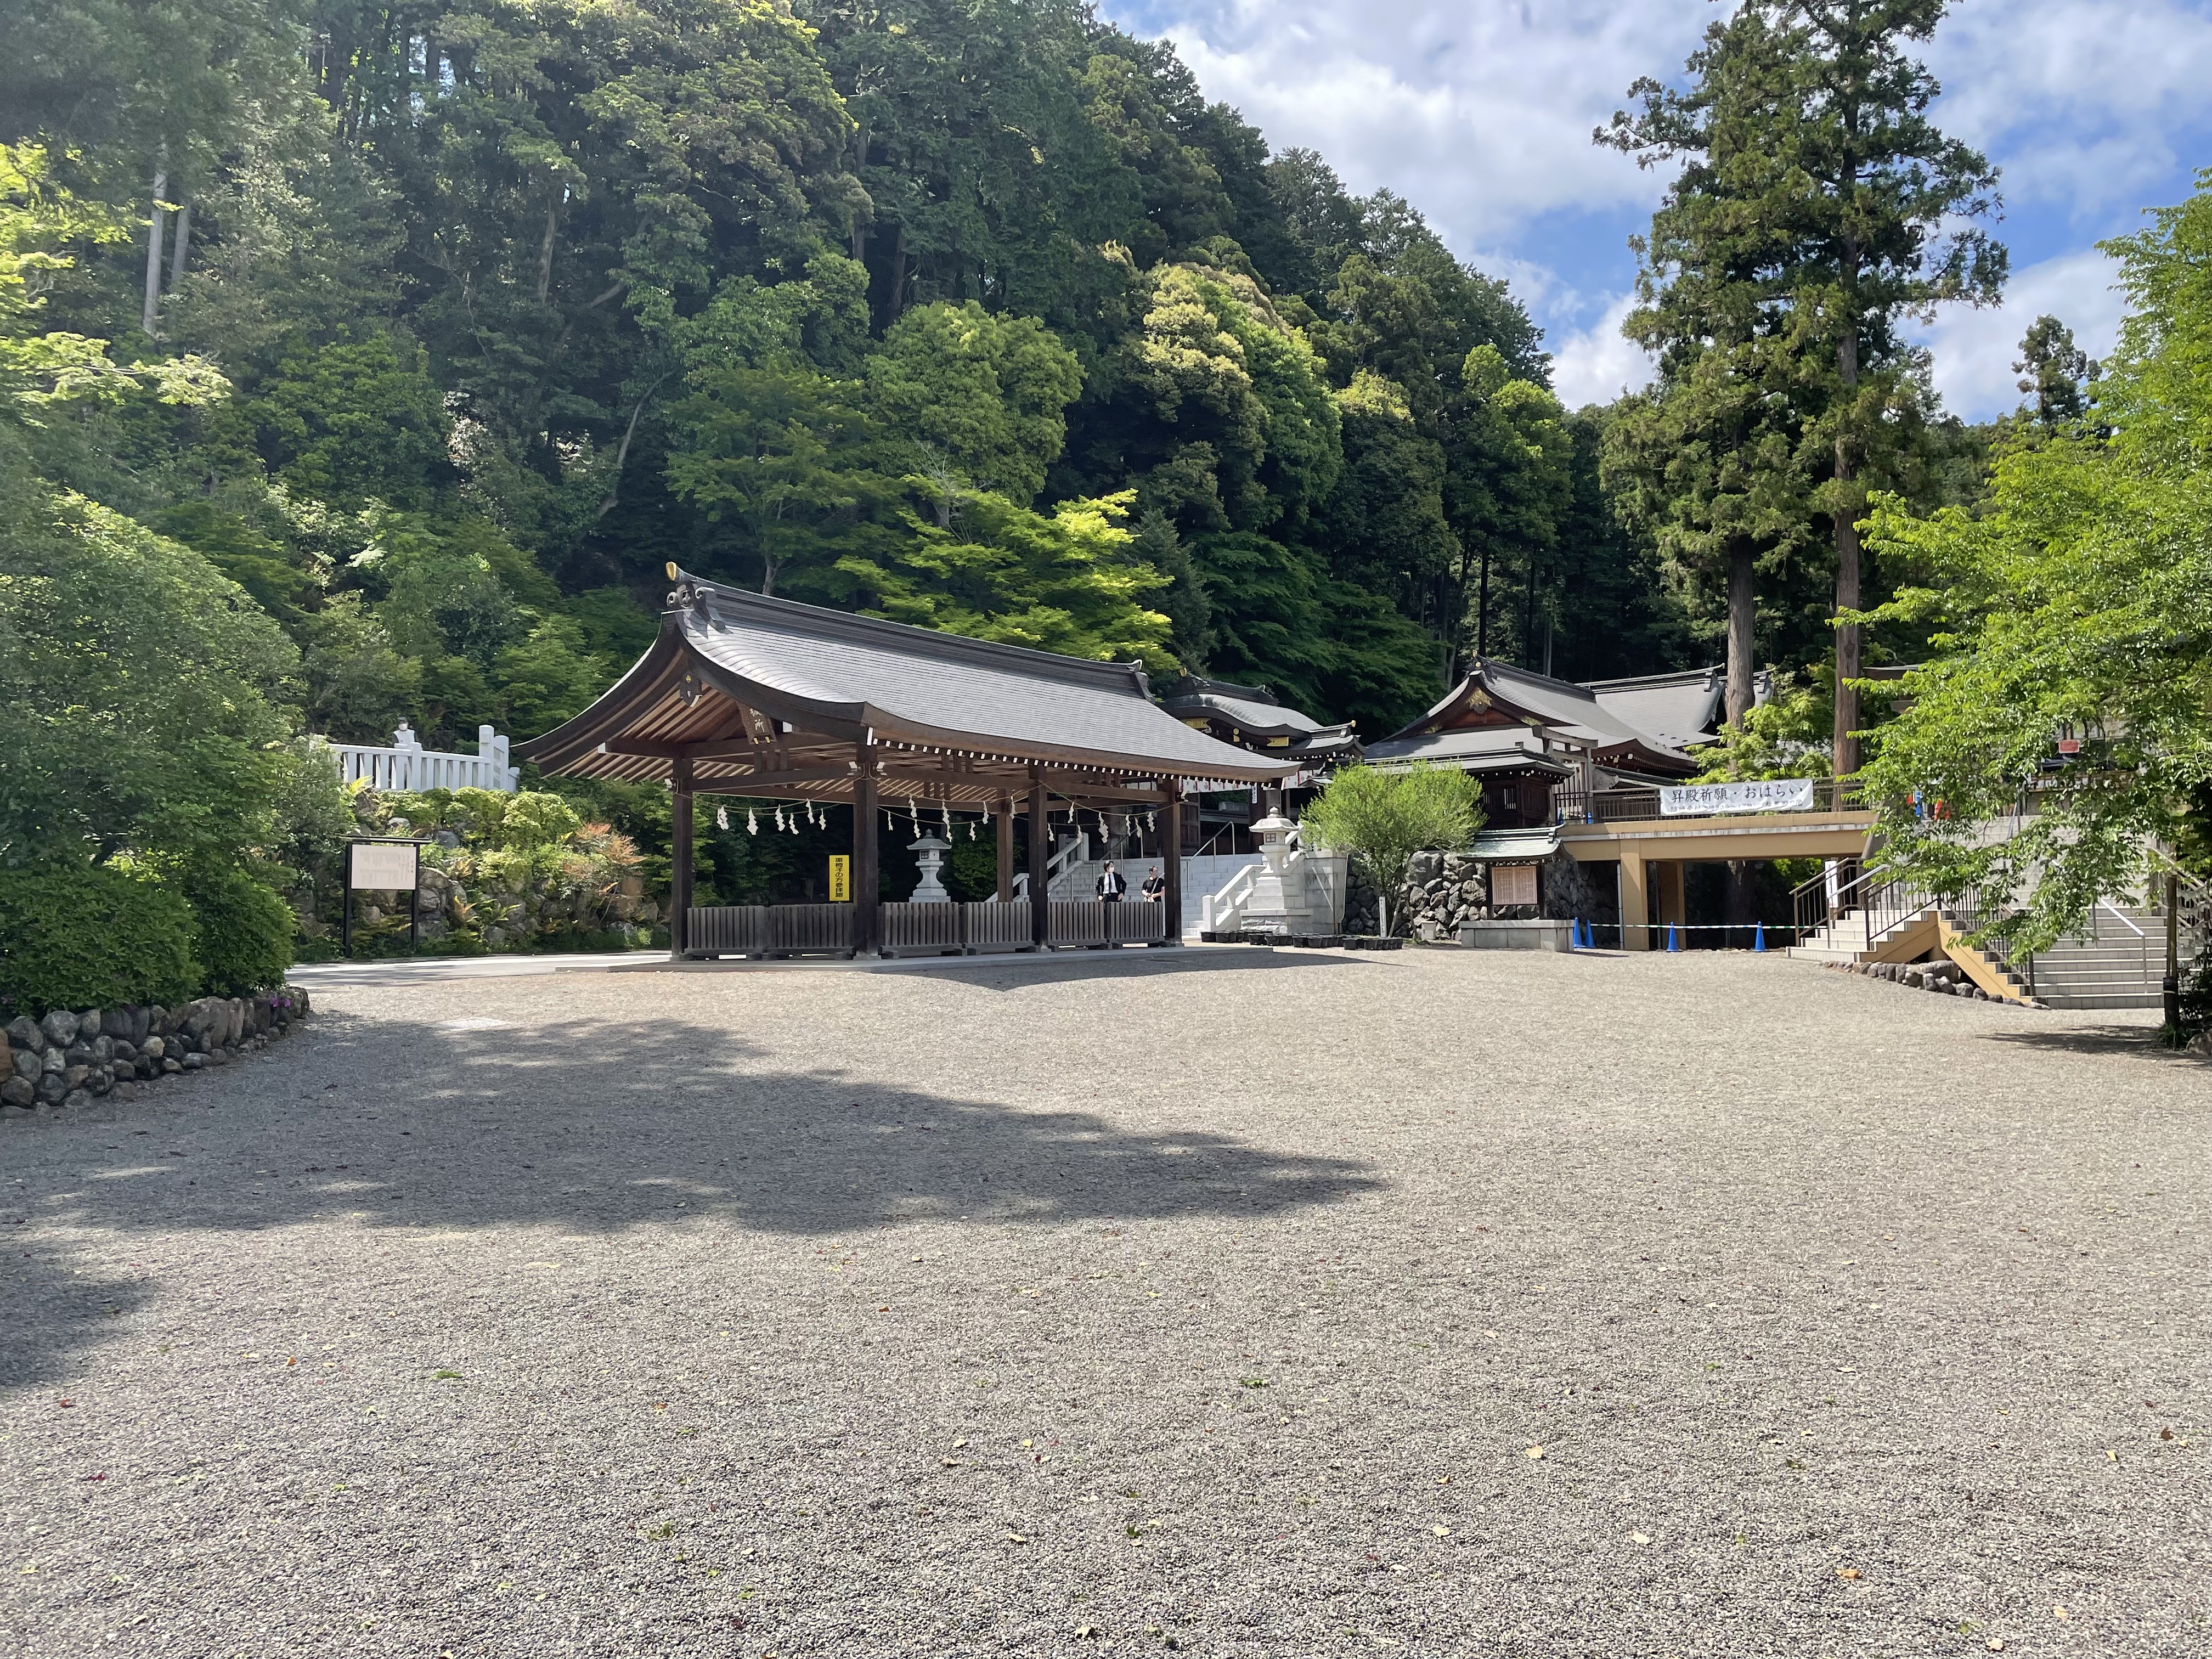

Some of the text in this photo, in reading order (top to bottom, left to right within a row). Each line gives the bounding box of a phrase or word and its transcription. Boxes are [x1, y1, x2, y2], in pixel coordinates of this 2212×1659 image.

[1671, 784, 1803, 803] 昇殿祈願・おはらい
[835, 857, 843, 898] 車椅子の方参拝路
